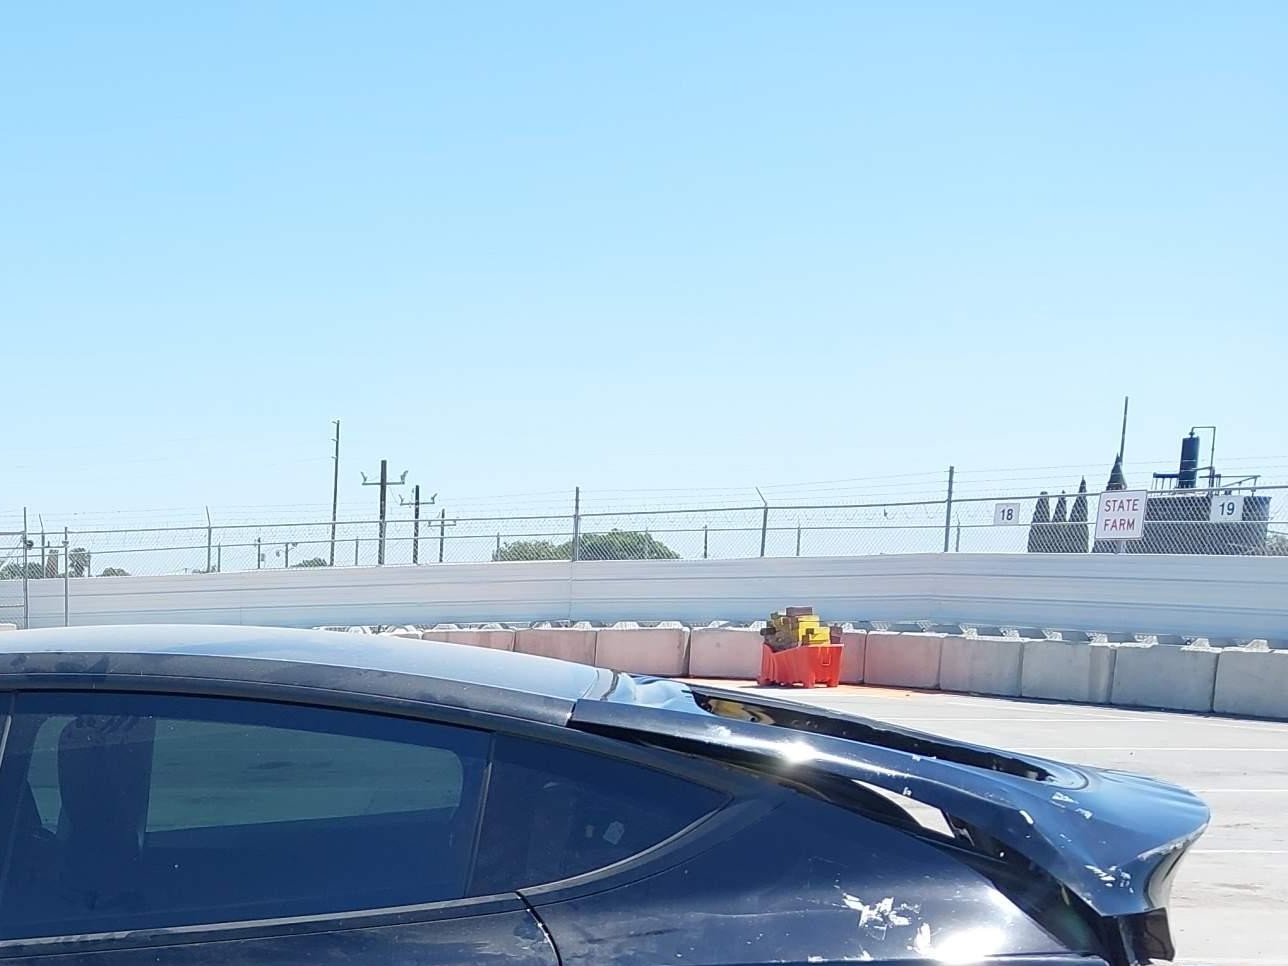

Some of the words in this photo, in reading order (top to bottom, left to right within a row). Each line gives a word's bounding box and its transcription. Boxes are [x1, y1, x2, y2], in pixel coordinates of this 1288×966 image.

[1104, 499, 1140, 512] STATE
[1219, 501, 1235, 516] 19
[1000, 508, 1014, 521] 18
[1103, 518, 1136, 531] FARM
